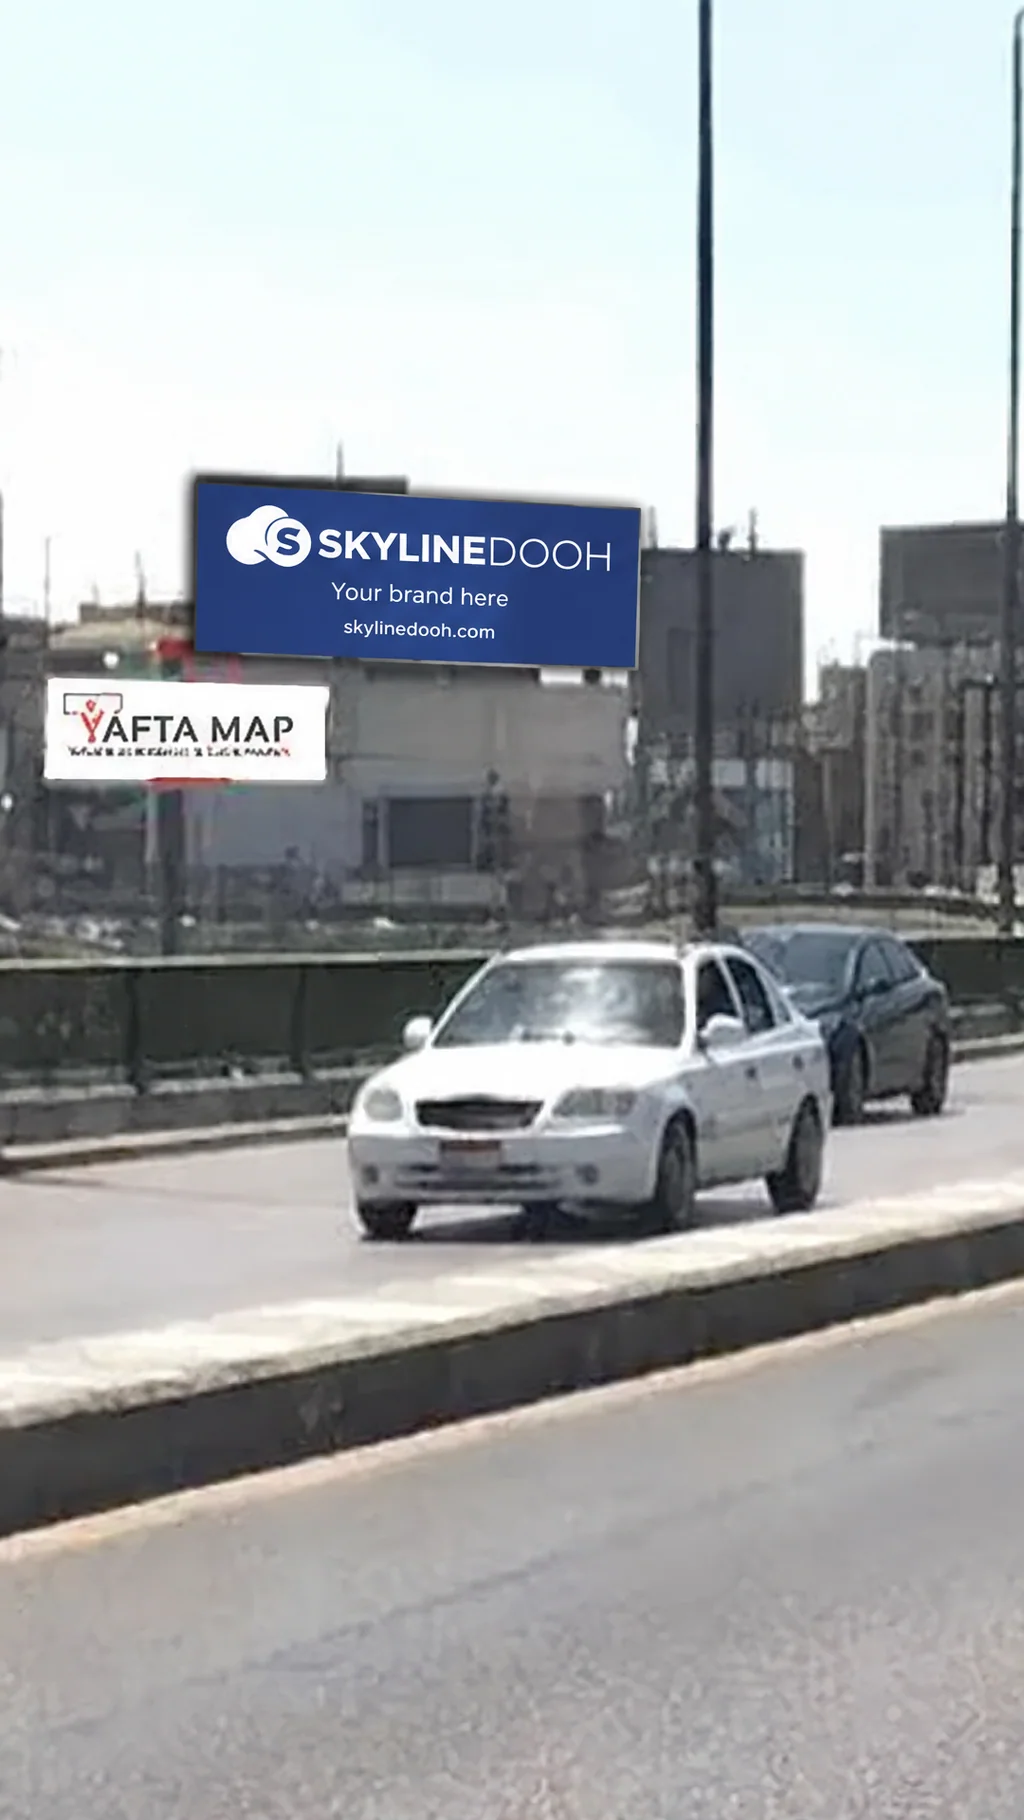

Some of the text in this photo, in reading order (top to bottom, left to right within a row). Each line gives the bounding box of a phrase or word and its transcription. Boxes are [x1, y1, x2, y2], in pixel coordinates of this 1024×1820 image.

[318, 528, 611, 571] SKYLINEDOOH
[331, 582, 509, 608] Your brand here
[343, 619, 496, 640] skylinedooh.com
[80, 710, 294, 744] YAFTA MAP
